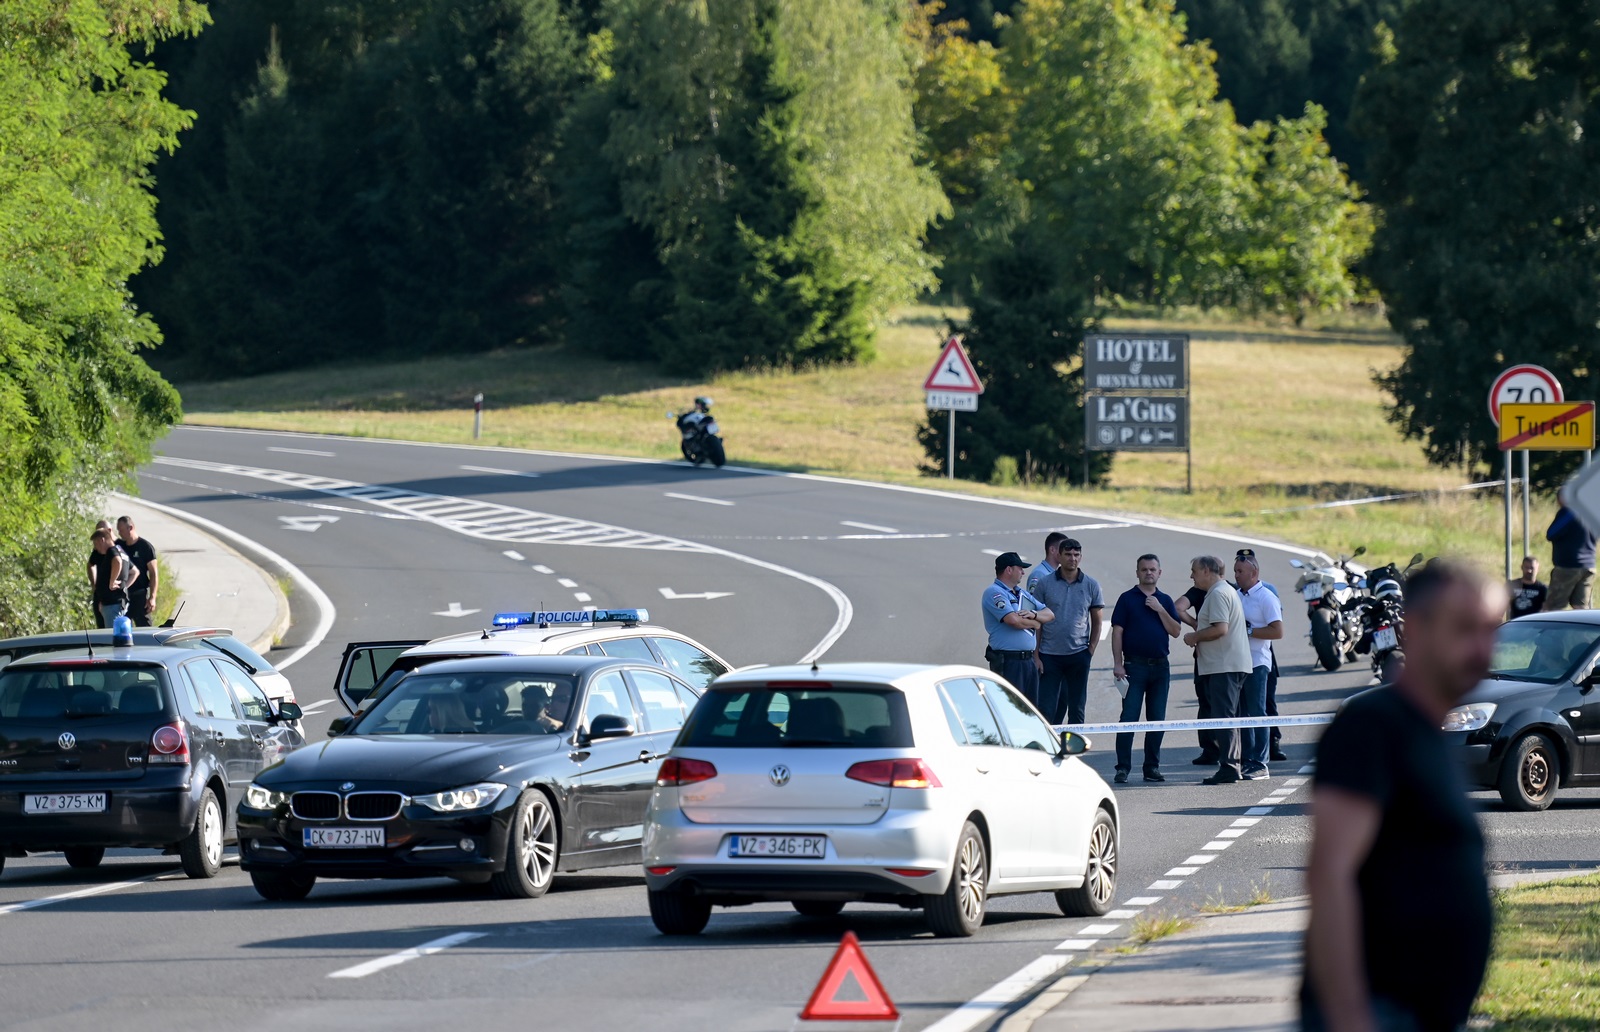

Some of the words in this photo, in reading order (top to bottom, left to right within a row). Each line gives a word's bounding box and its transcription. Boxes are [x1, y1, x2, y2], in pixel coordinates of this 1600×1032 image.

[1097, 339, 1176, 362] HOTEL
[1129, 361, 1142, 374] &
[1098, 397, 1176, 422] La'Gus
[537, 611, 589, 623] POLICIJA
[34, 796, 49, 809] VZ
[58, 795, 103, 808] 375-KM
[312, 830, 326, 844] CK
[335, 830, 381, 844] 737-HV
[741, 838, 757, 853] VZ
[768, 838, 821, 854] 346-PK
